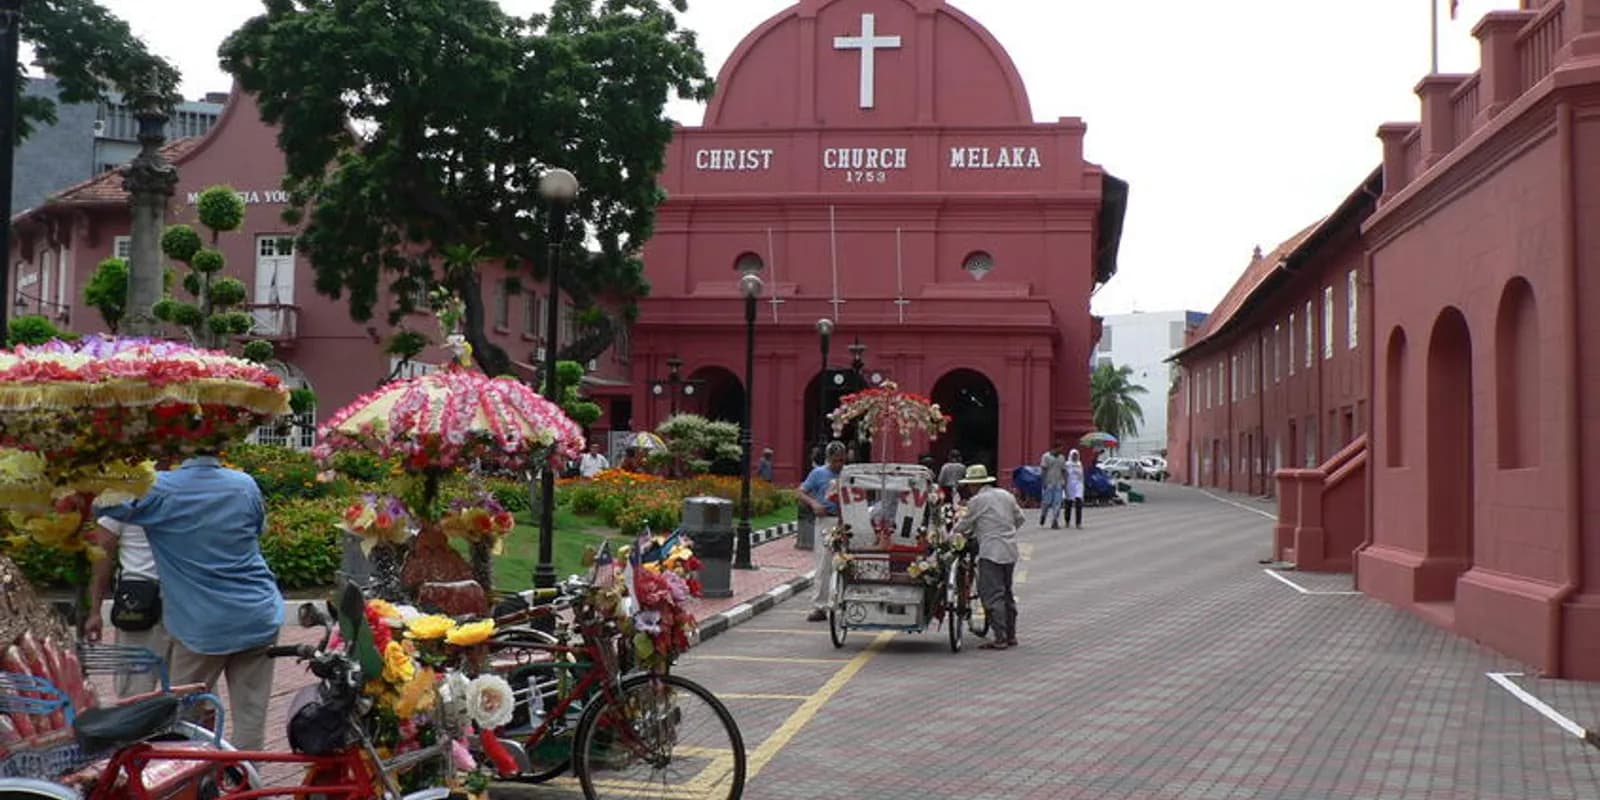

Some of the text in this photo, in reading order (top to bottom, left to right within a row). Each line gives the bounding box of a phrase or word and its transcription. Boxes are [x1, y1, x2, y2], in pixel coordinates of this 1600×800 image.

[696, 147, 1042, 170] CHRIST CHURCH MELAKA
[845, 171, 887, 183] 1753
